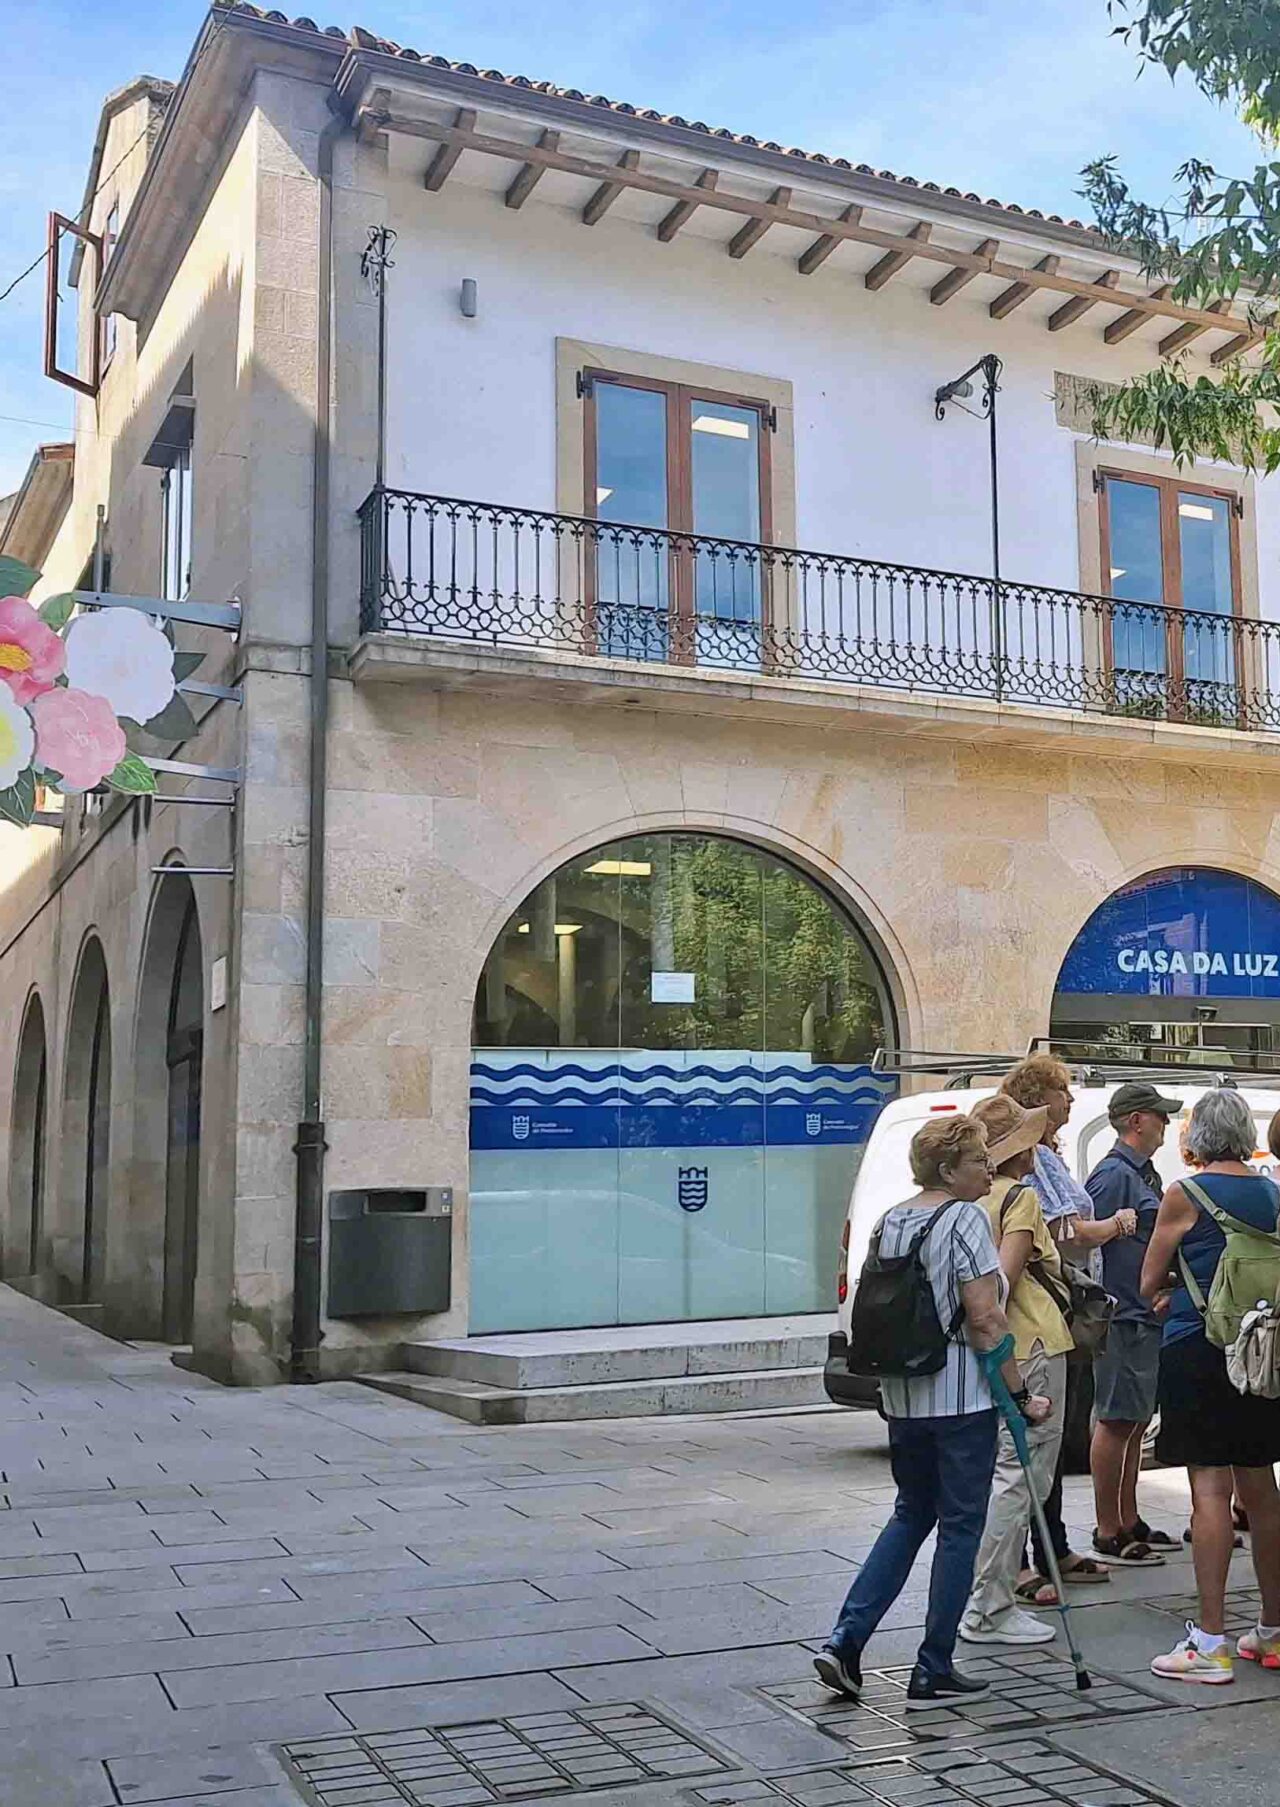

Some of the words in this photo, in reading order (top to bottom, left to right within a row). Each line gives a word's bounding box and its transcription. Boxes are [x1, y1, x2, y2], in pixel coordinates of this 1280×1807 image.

[1117, 949, 1188, 974] CASA
[1192, 951, 1228, 975] DA
[1233, 953, 1279, 977] LUZ
